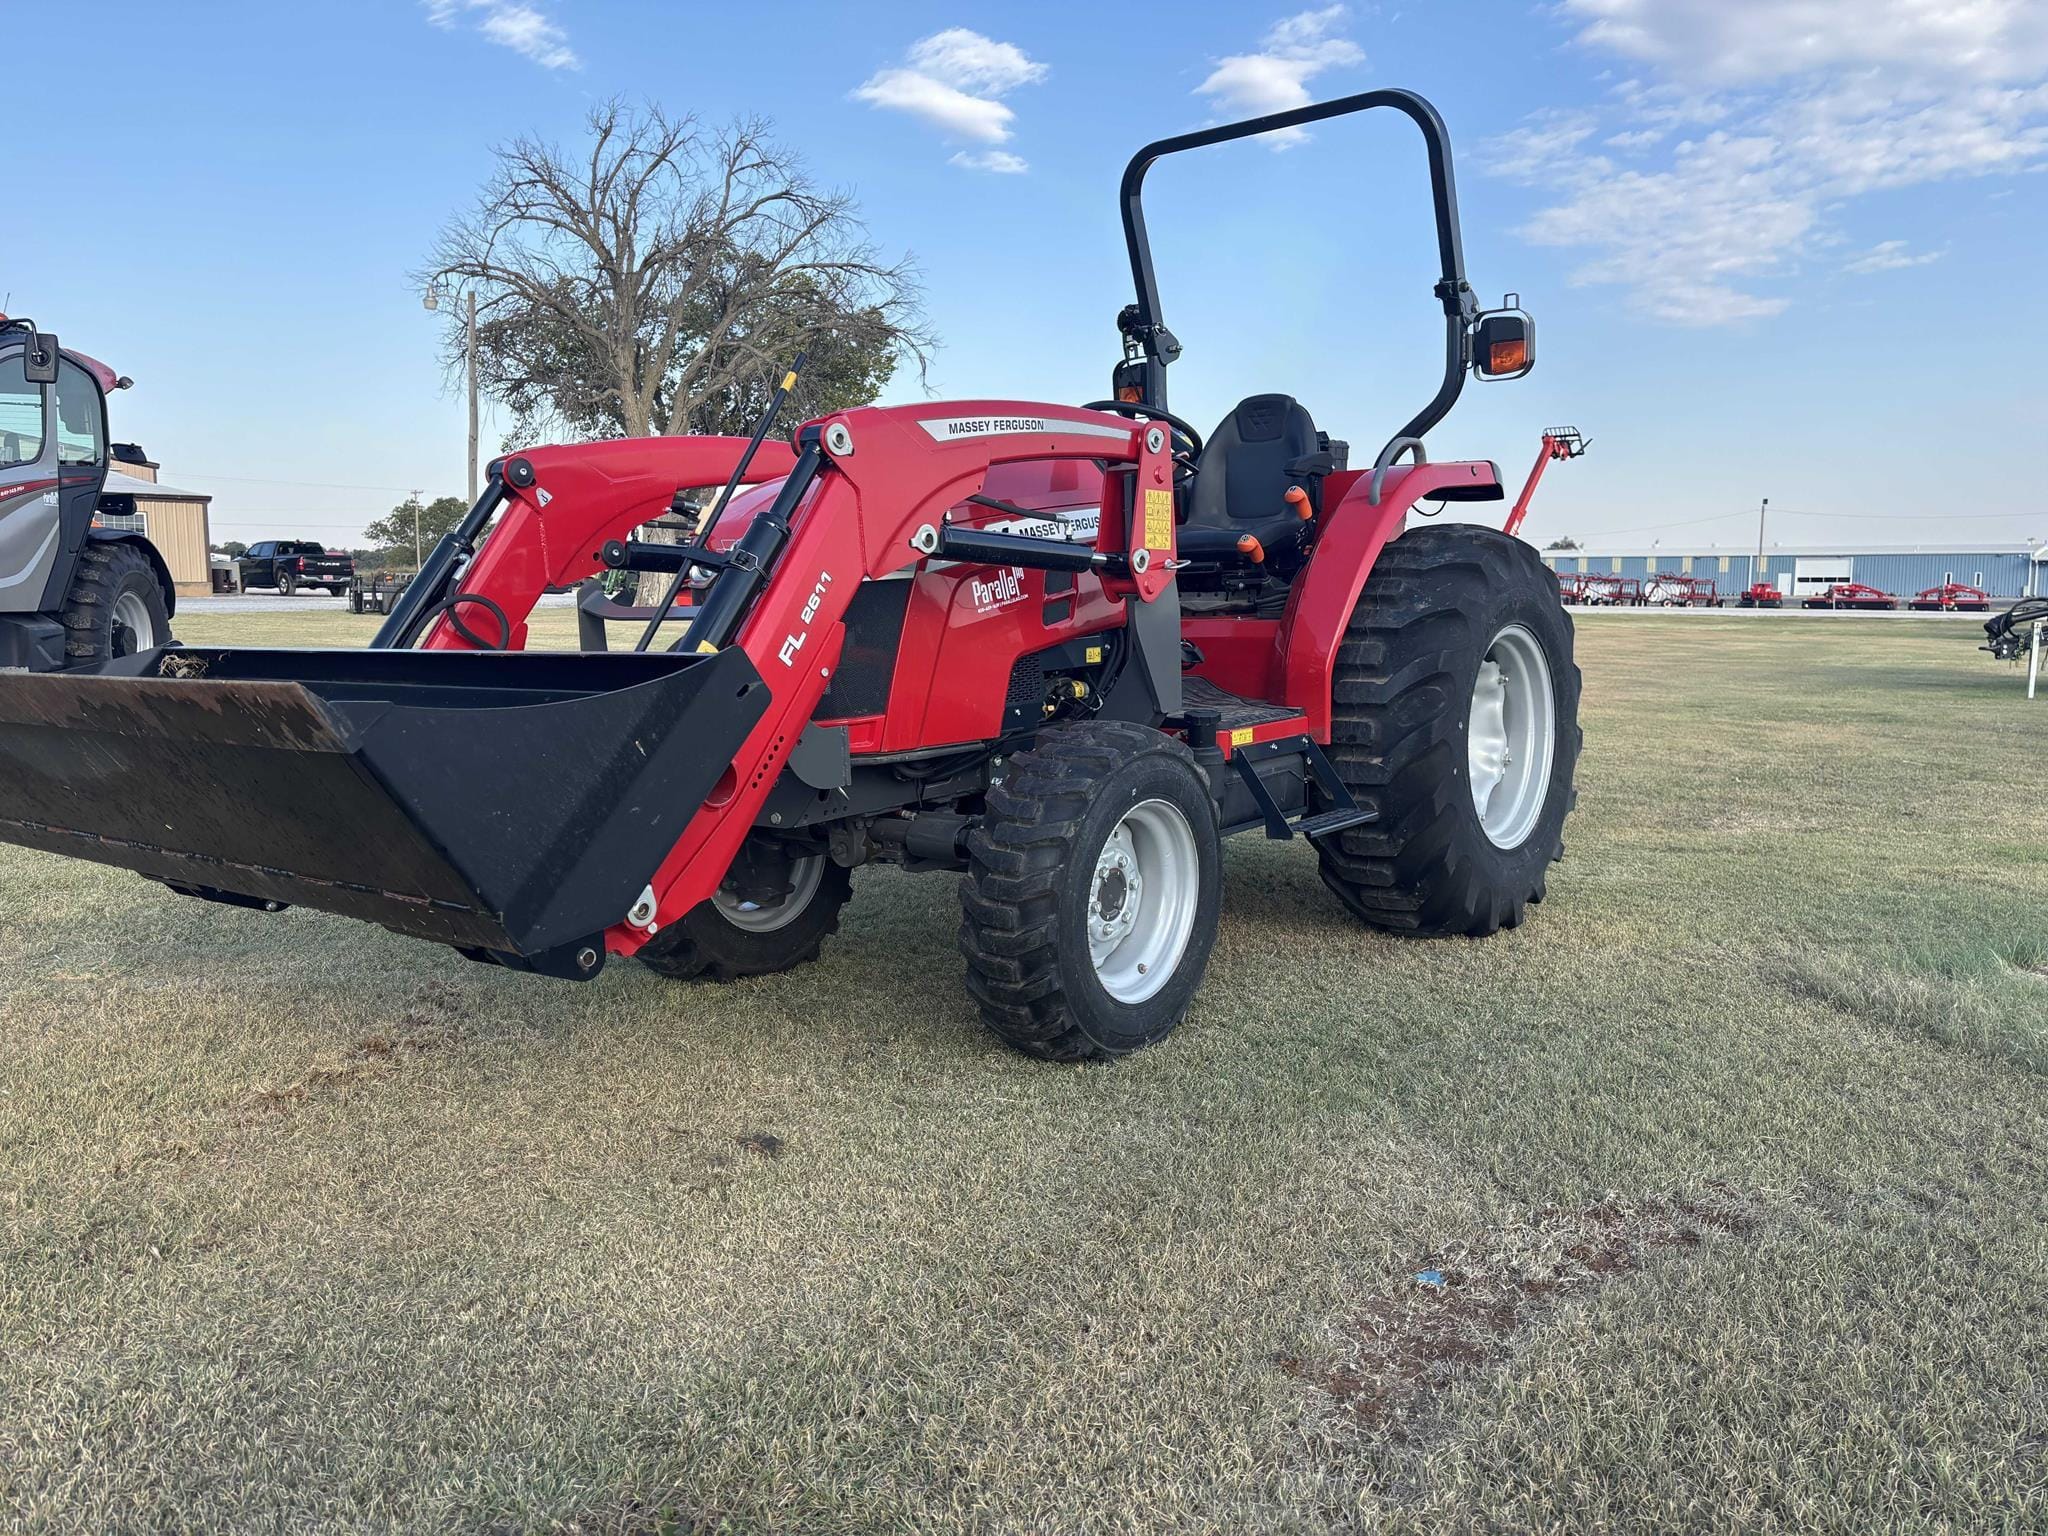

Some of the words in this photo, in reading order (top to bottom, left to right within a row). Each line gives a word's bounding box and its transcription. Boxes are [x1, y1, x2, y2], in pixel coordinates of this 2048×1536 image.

[948, 420, 990, 435] MASSEY
[994, 419, 1044, 431] FERGUSON
[1019, 521, 1060, 537] MASSEY
[971, 566, 1020, 606] Parallel
[778, 631, 807, 668] FL
[801, 571, 832, 625] 2611
